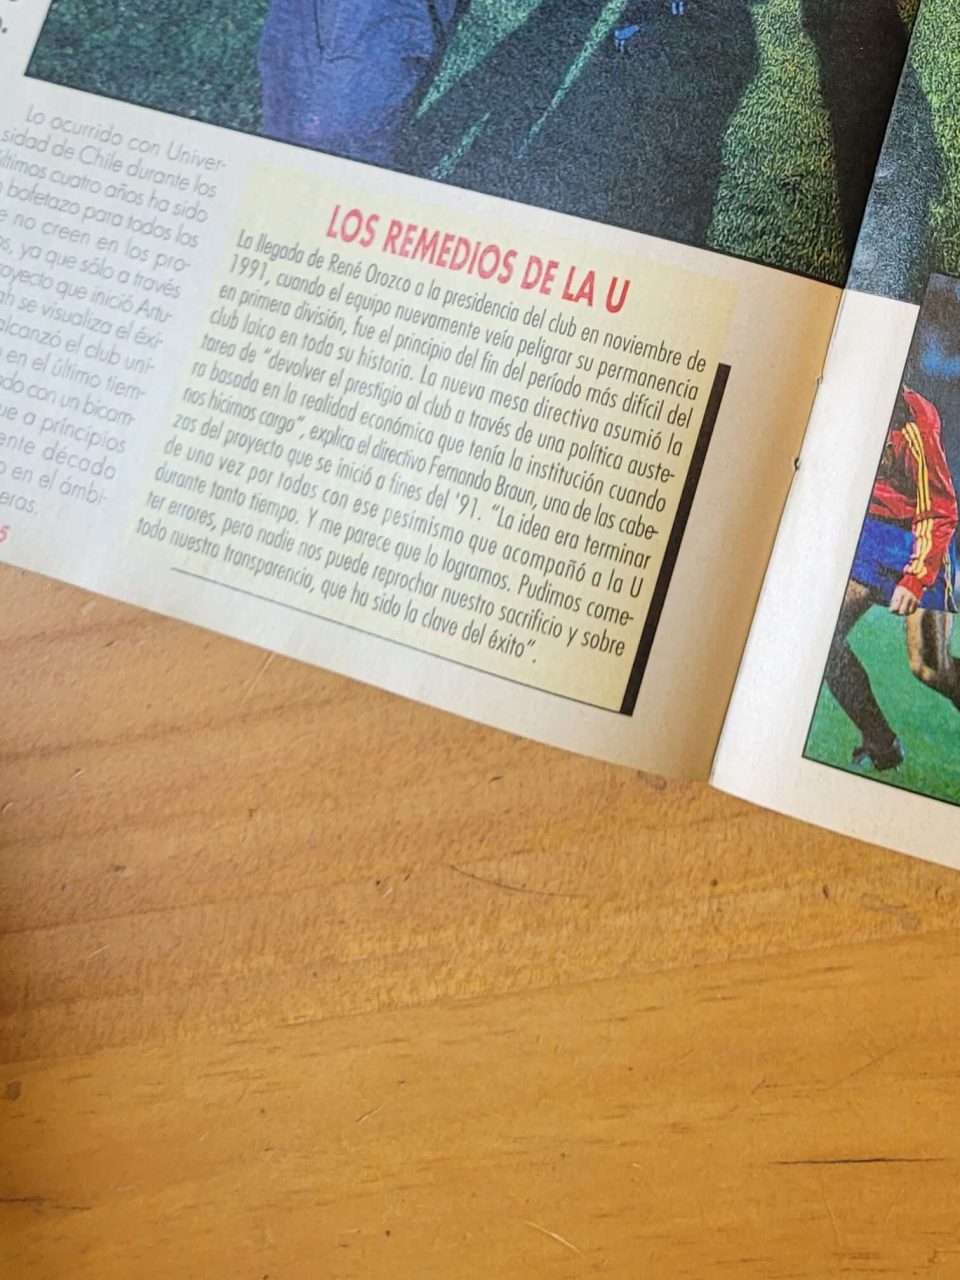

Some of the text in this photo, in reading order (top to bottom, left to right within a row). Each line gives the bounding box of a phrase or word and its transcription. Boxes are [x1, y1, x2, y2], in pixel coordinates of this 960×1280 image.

[24, 103, 228, 172] Lo ocurrido con Univer-
[237, 228, 708, 374] La llegada de René Orozco a la presidencia del club en noviembre de
[325, 204, 632, 315] LOS REMEDIOS DE LA U
